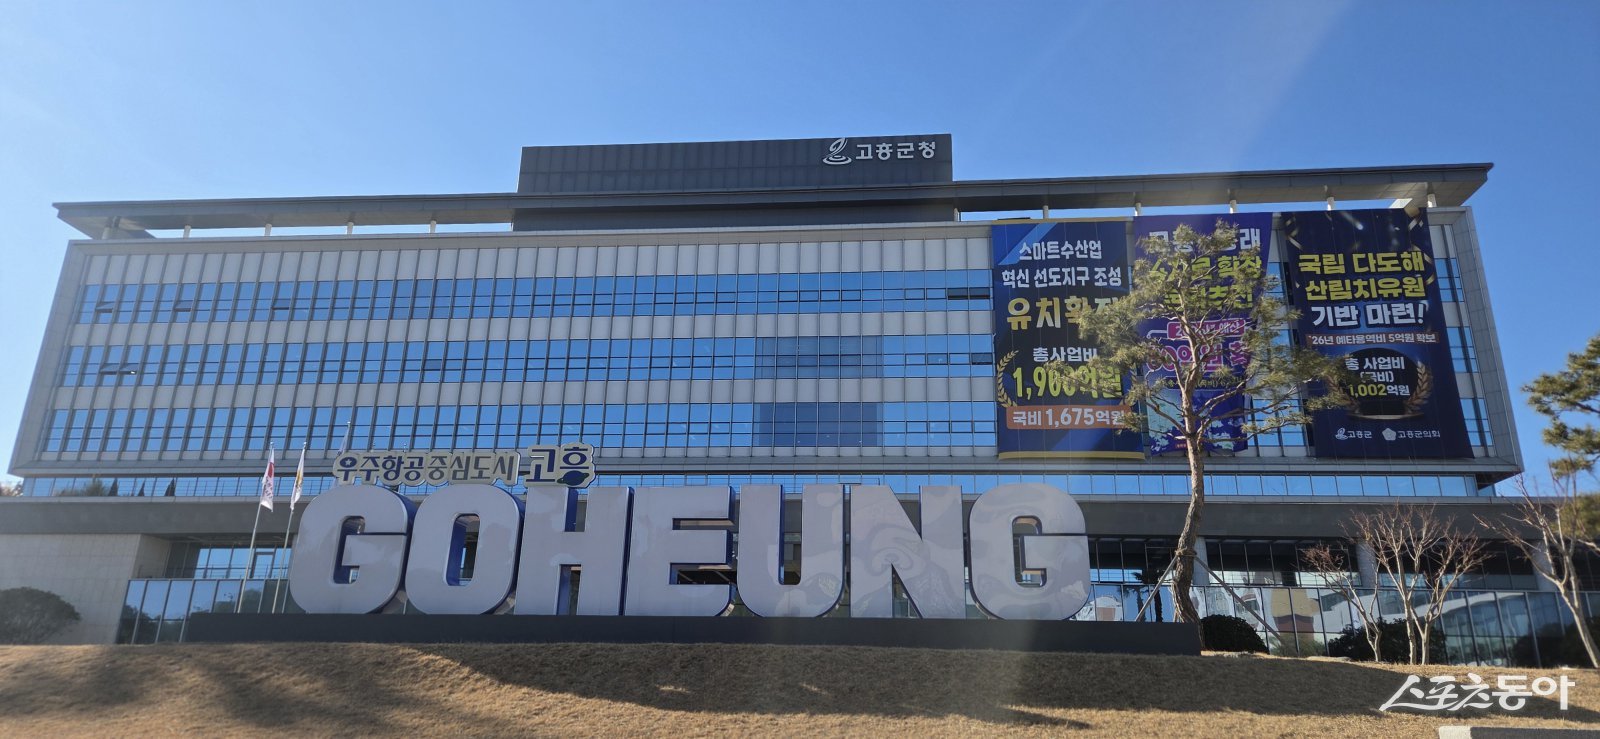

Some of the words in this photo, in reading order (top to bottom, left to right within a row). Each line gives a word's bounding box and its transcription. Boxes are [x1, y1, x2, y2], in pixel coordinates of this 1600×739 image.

[856, 141, 936, 161] 고흥군청
[1019, 240, 1102, 261] 스마트수산업
[1298, 253, 1345, 275] 국립
[1352, 250, 1425, 273] 다도해
[1002, 269, 1030, 289] 혁신
[1034, 267, 1090, 288] 선도지구
[1094, 266, 1122, 287] 조성
[1163, 284, 1253, 311] 추진
[1305, 276, 1426, 301] 산림치유원
[1311, 304, 1358, 327] 기반
[1367, 301, 1426, 326] 마련!
[1336, 334, 1386, 344] 예타용역비
[1388, 333, 1415, 343] 5억원
[1416, 333, 1437, 343] 확보
[1032, 346, 1098, 363] 총사업비
[1345, 356, 1360, 370] 총
[1363, 356, 1405, 370] 사업비
[1349, 384, 1411, 398] 1,002억원
[1013, 410, 1042, 427] 국비
[1045, 407, 1126, 428] 1,675억원
[1347, 430, 1373, 439] 고흥군
[1397, 430, 1441, 439] 고흥군의회
[336, 454, 515, 483] 우주항공중심도시
[526, 445, 591, 487] 고흥
[289, 483, 1092, 620] GOHEUNG
